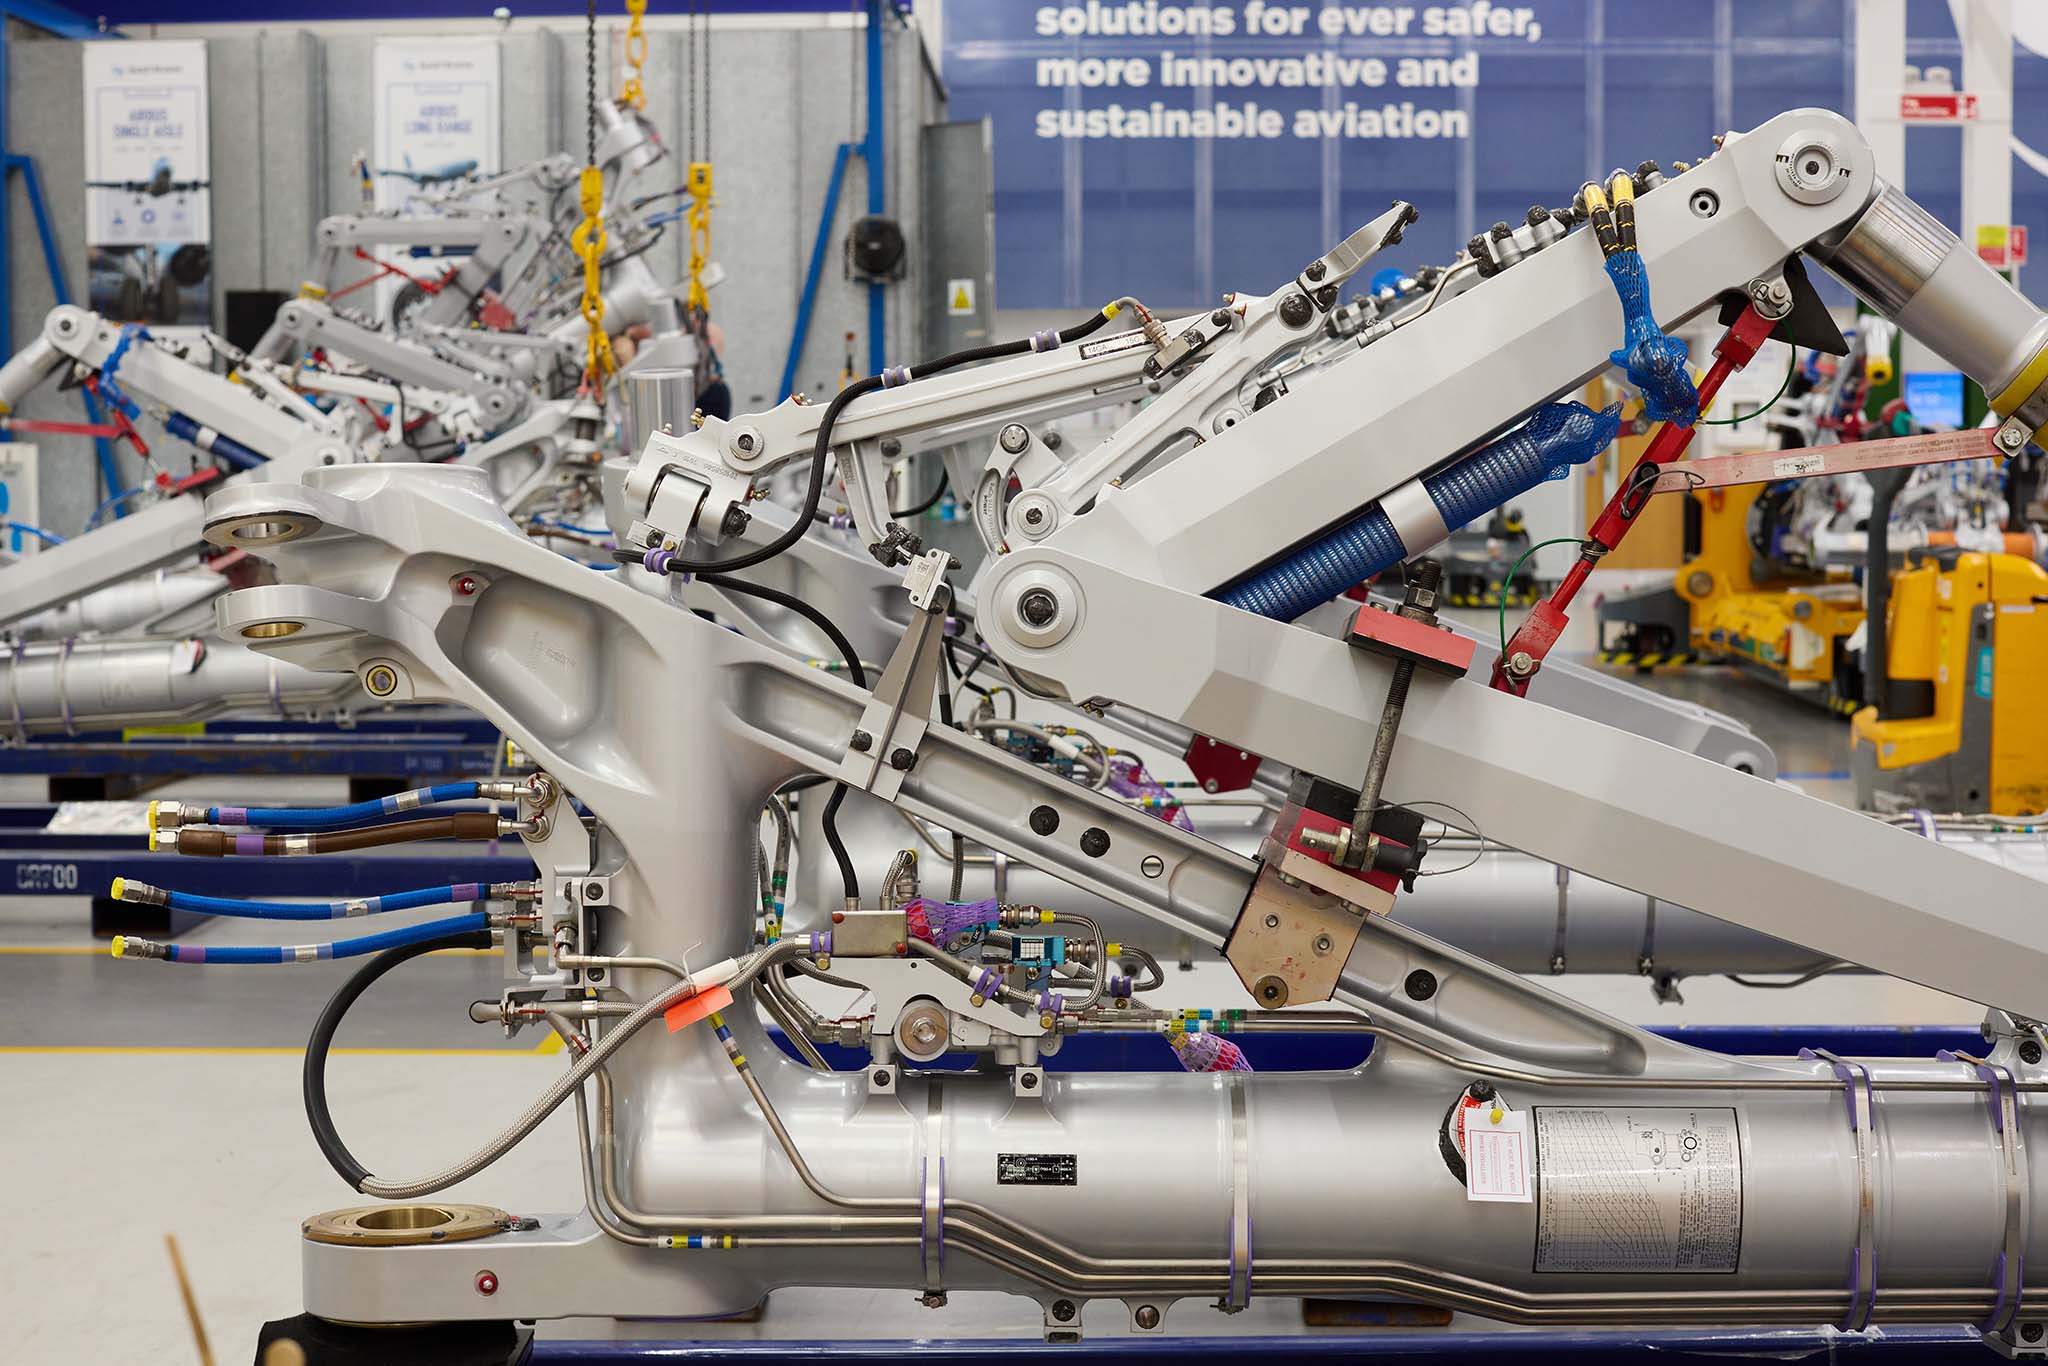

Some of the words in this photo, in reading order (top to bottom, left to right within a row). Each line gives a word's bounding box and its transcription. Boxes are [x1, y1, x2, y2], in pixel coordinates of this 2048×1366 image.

[1036, 1, 1236, 35] solutions
[1244, 0, 1309, 35] for
[1318, 7, 1415, 35] ever
[1423, 0, 1541, 42] safer,
[1036, 58, 1150, 87] more
[1160, 51, 1387, 87] innovative
[1396, 51, 1479, 87] and
[1036, 102, 1284, 138] sustainable
[1293, 102, 1468, 138] aviation
